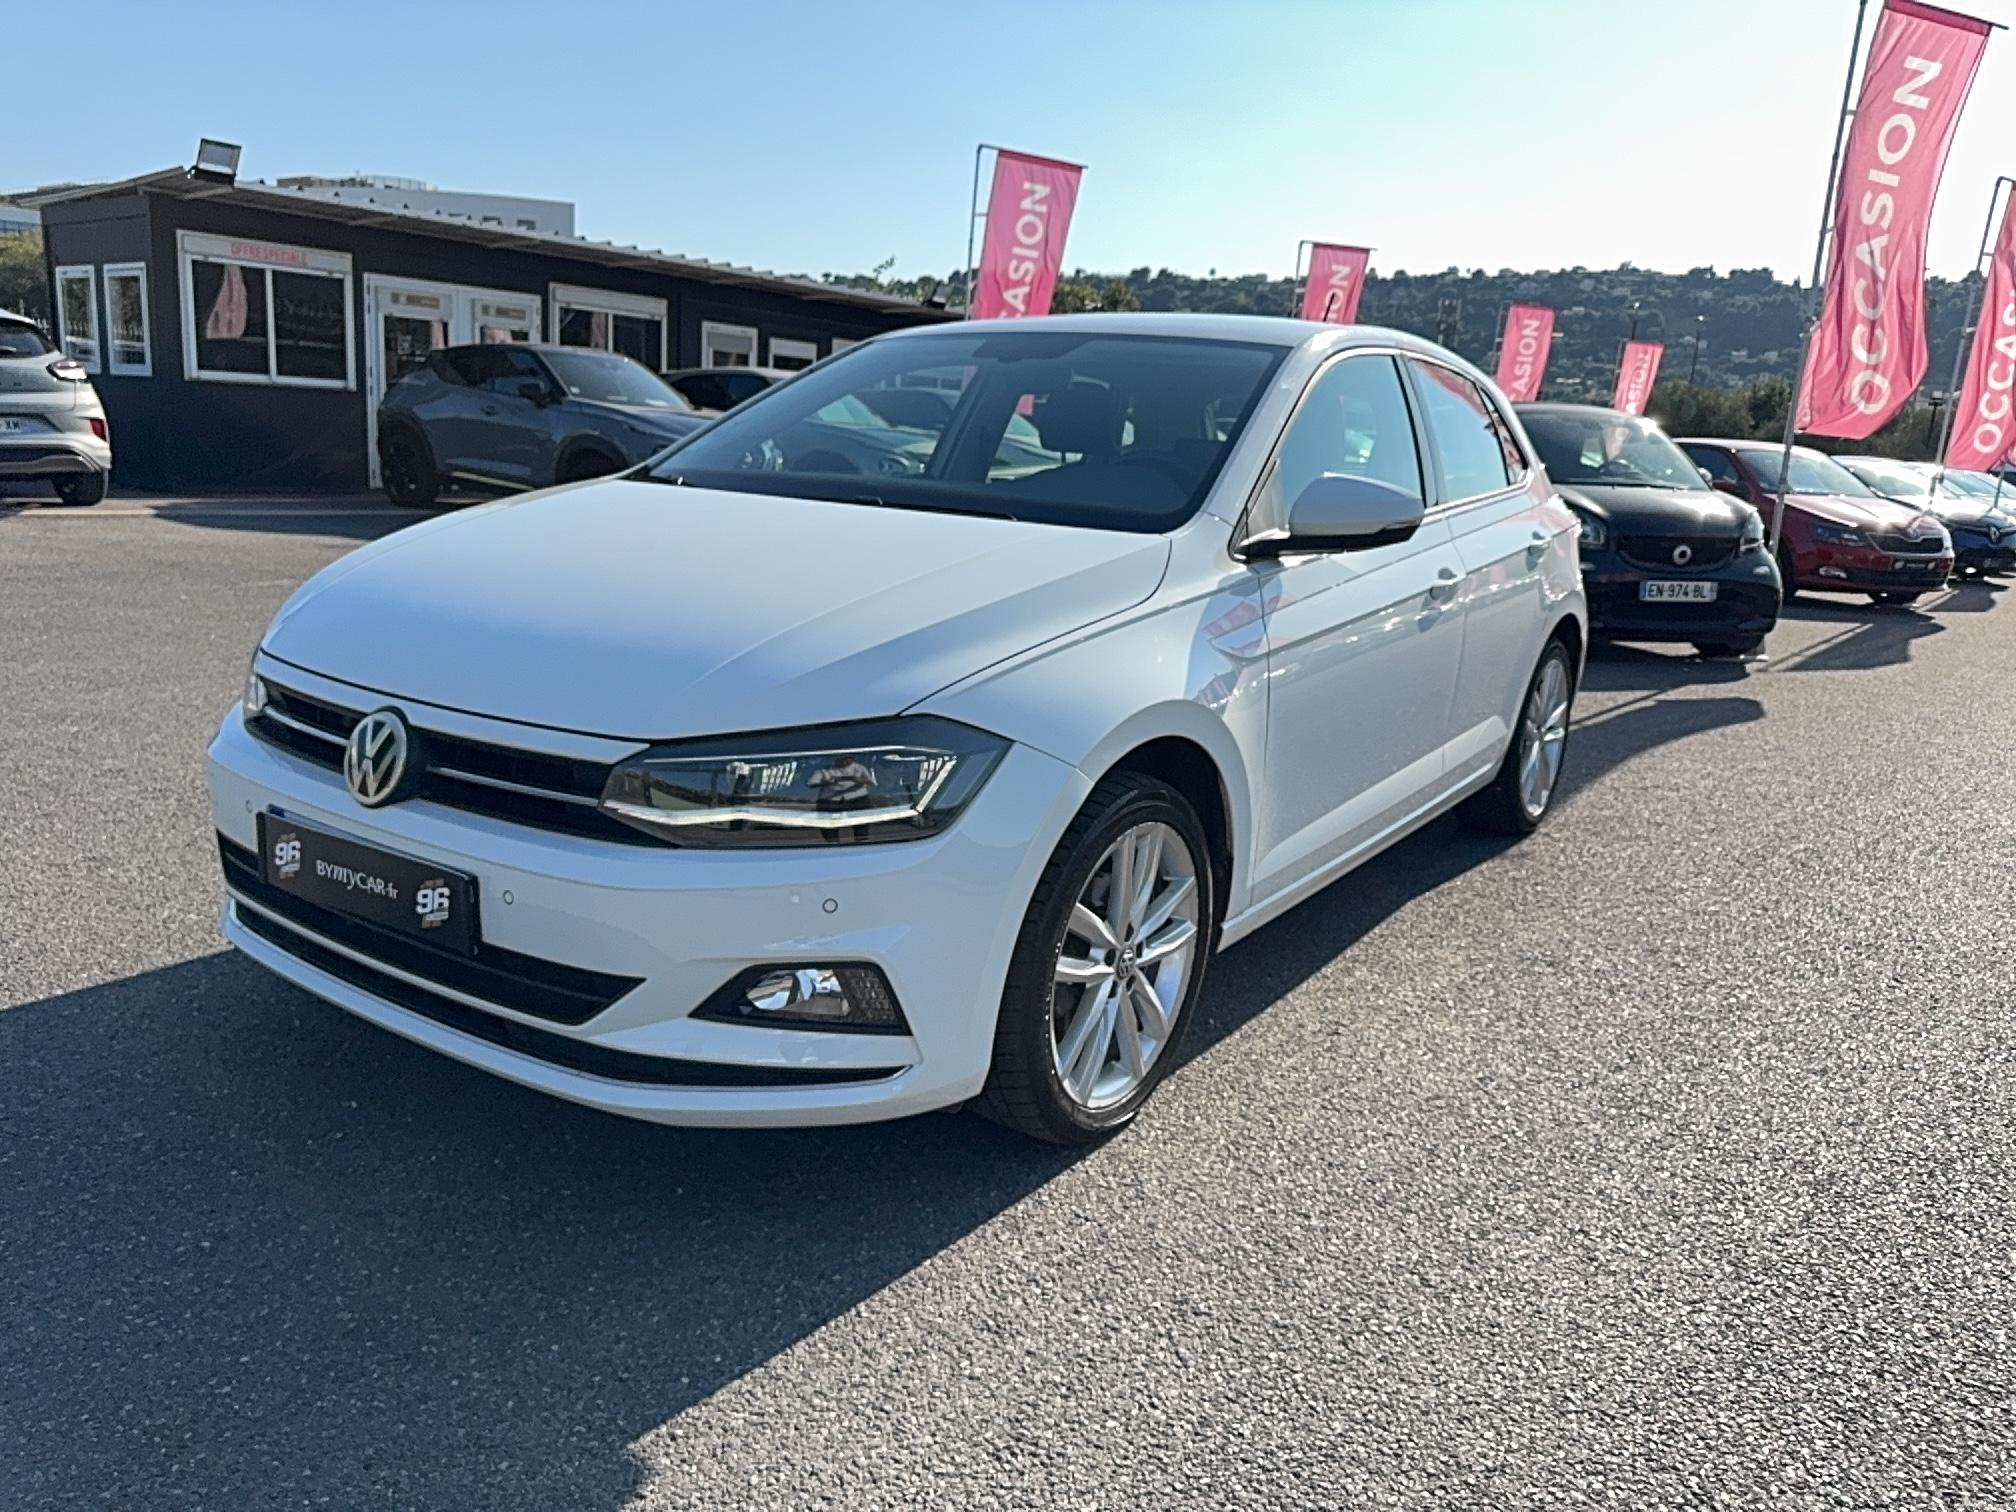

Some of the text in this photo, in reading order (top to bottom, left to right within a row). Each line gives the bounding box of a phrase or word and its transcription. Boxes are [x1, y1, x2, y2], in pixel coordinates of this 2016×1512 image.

[998, 181, 1051, 319] ASION
[1850, 55, 1943, 415] OCCASION
[1510, 319, 1541, 400] ASION
[1974, 289, 2016, 454] OCCAS
[275, 840, 301, 867] 96
[416, 886, 450, 915] 96
